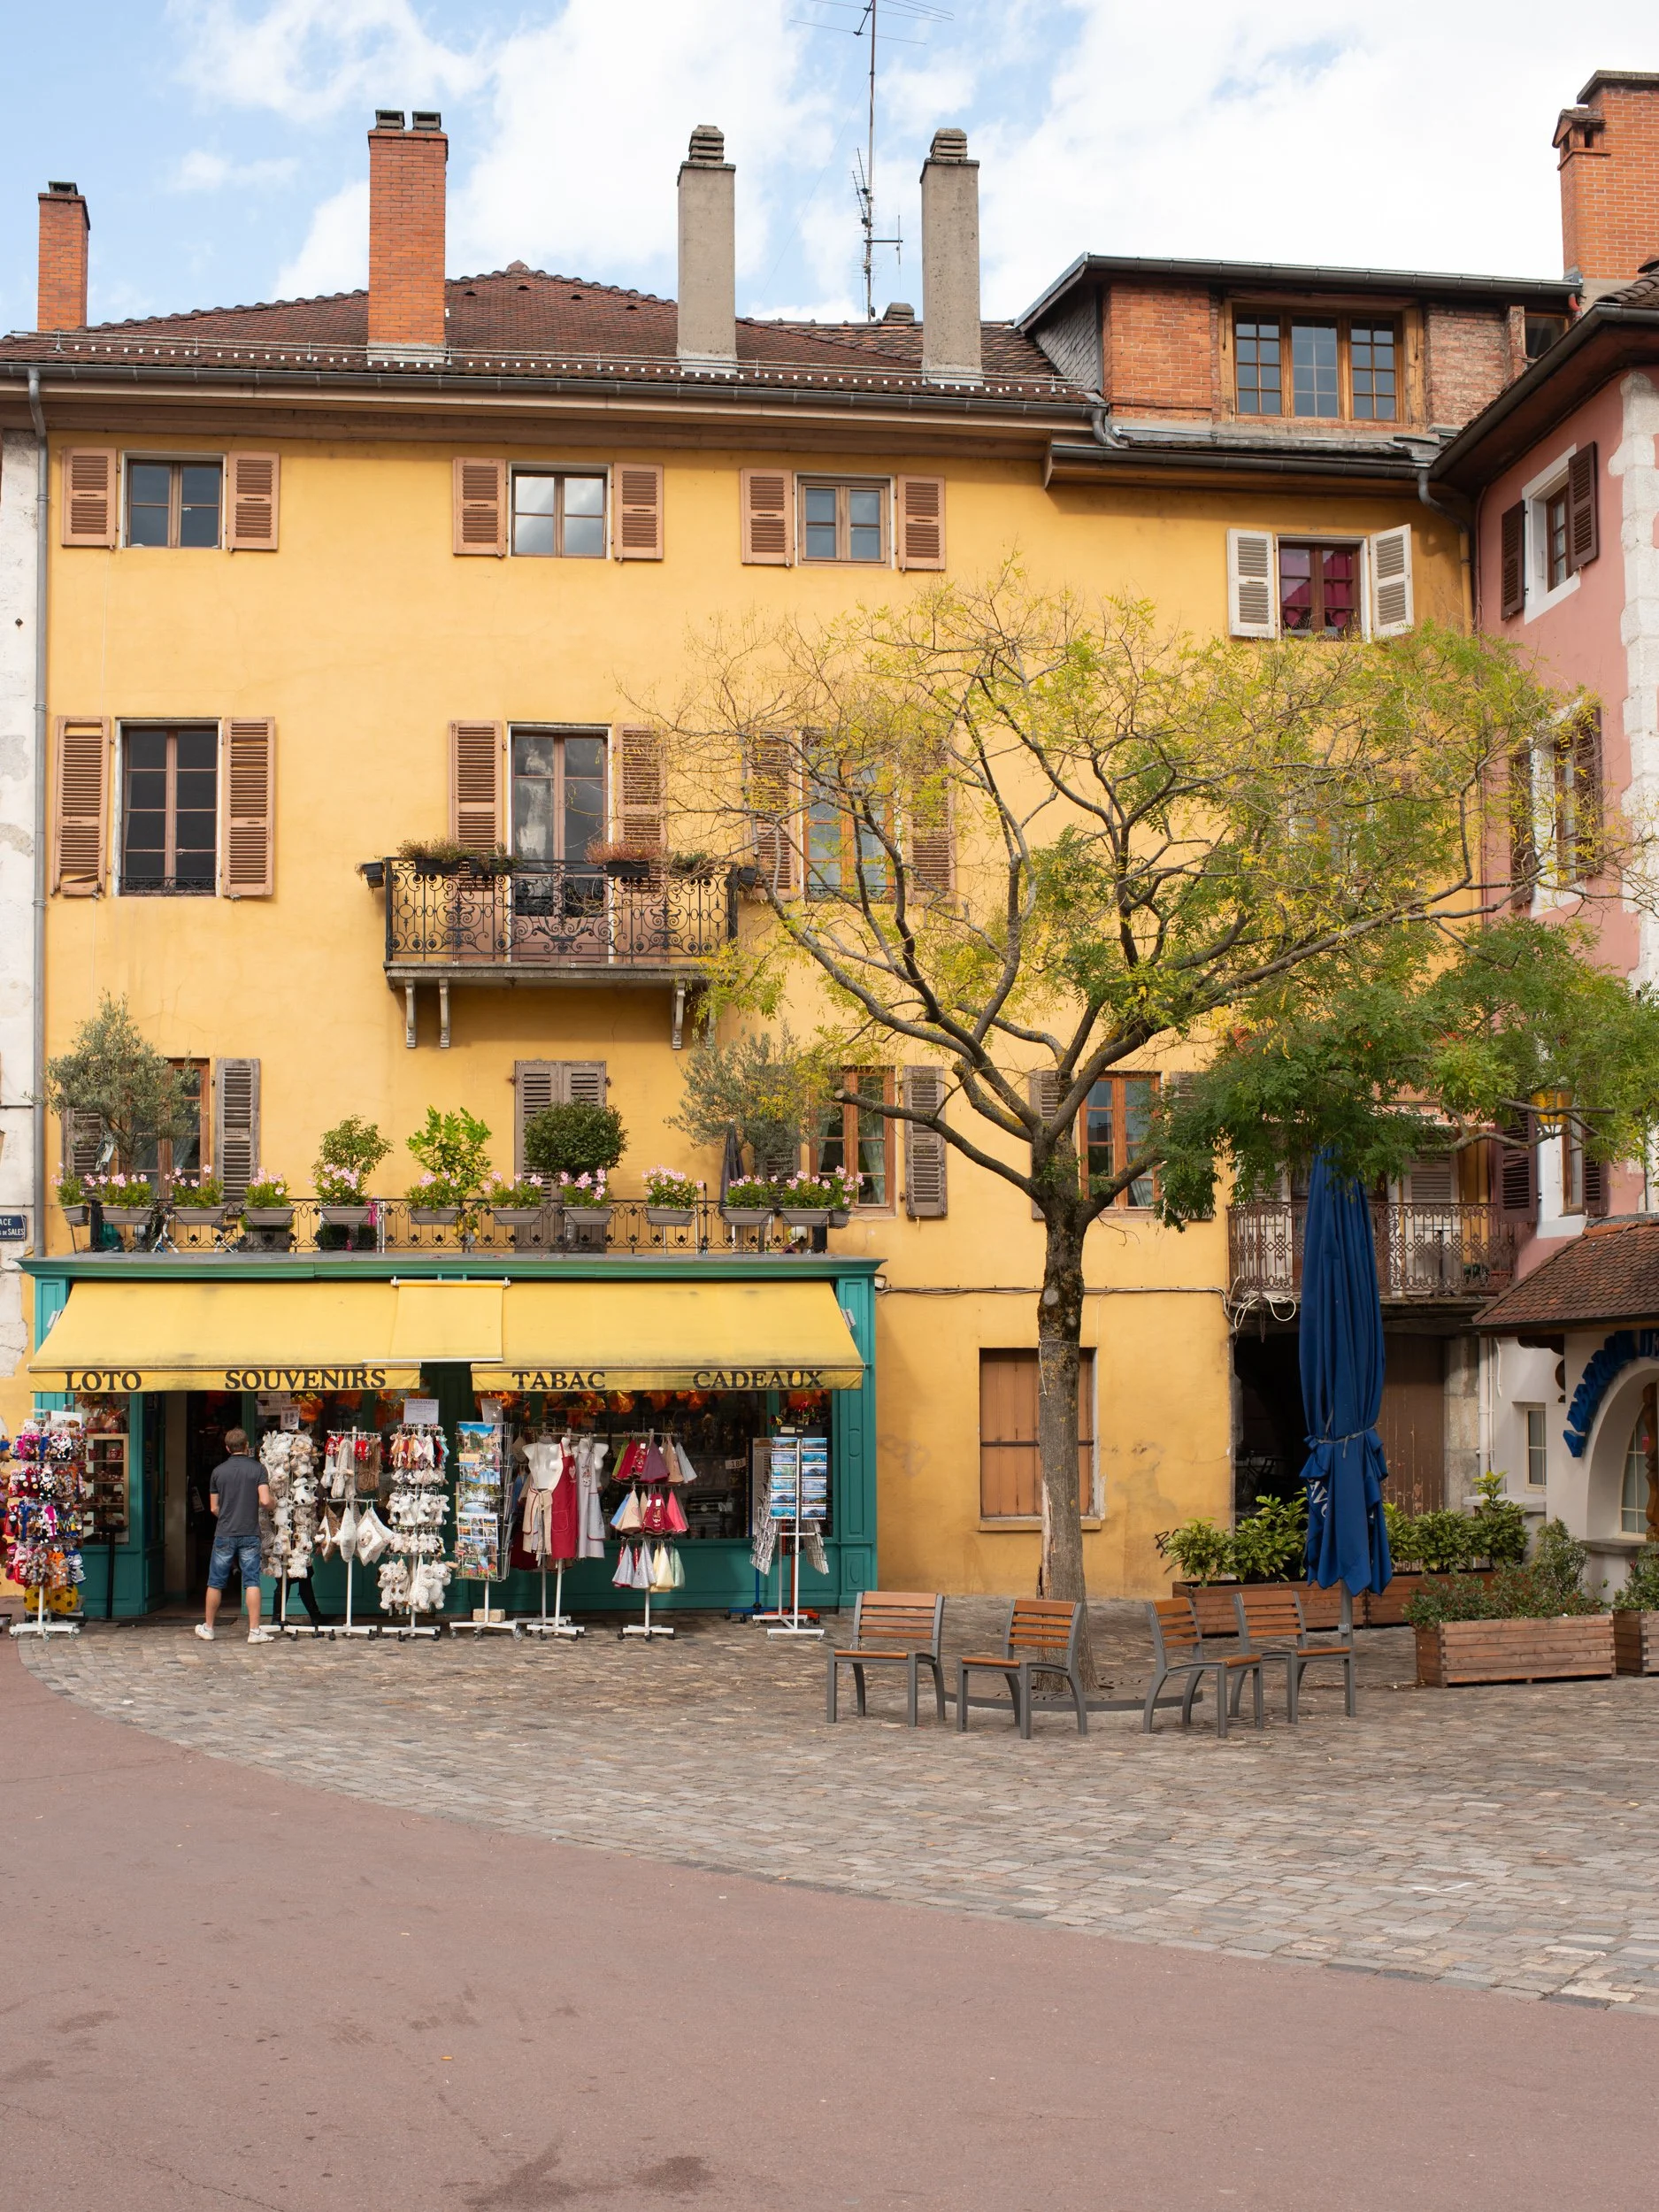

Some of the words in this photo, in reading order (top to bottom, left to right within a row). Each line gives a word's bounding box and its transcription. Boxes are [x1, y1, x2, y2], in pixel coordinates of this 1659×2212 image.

[65, 1371, 142, 1392] LOTO
[225, 1369, 387, 1390] SOUVENIRS
[511, 1371, 606, 1390] TABAC
[693, 1371, 825, 1389] CADEAUX
